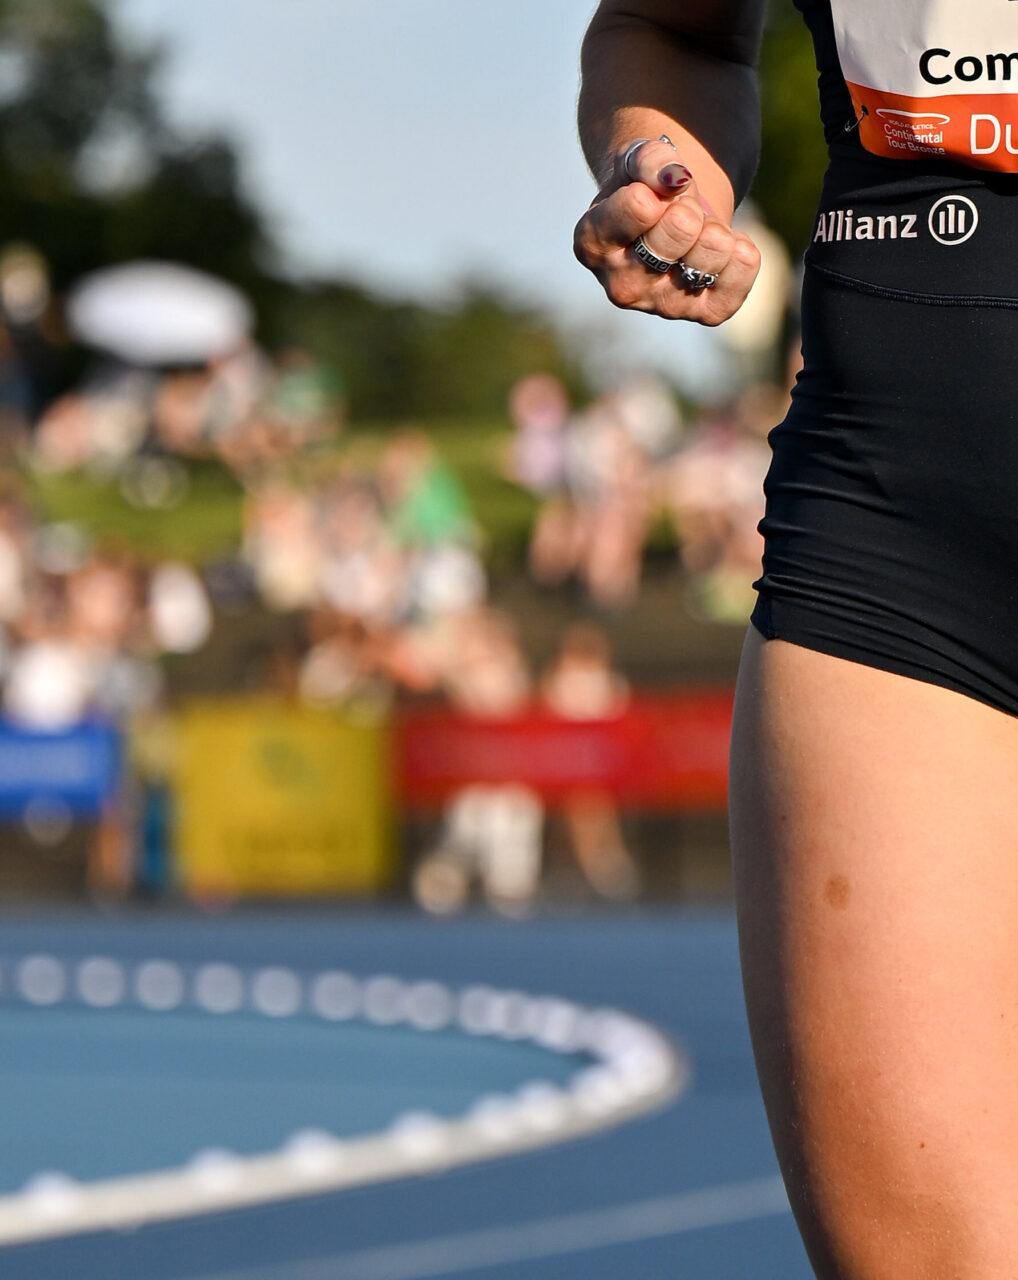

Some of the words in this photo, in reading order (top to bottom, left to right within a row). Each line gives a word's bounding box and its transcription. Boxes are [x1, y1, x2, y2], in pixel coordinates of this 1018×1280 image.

[884, 123, 943, 144] Continental
[885, 135, 906, 149] Tour
[907, 141, 945, 155] Bronze
[813, 209, 918, 243] Allianz
